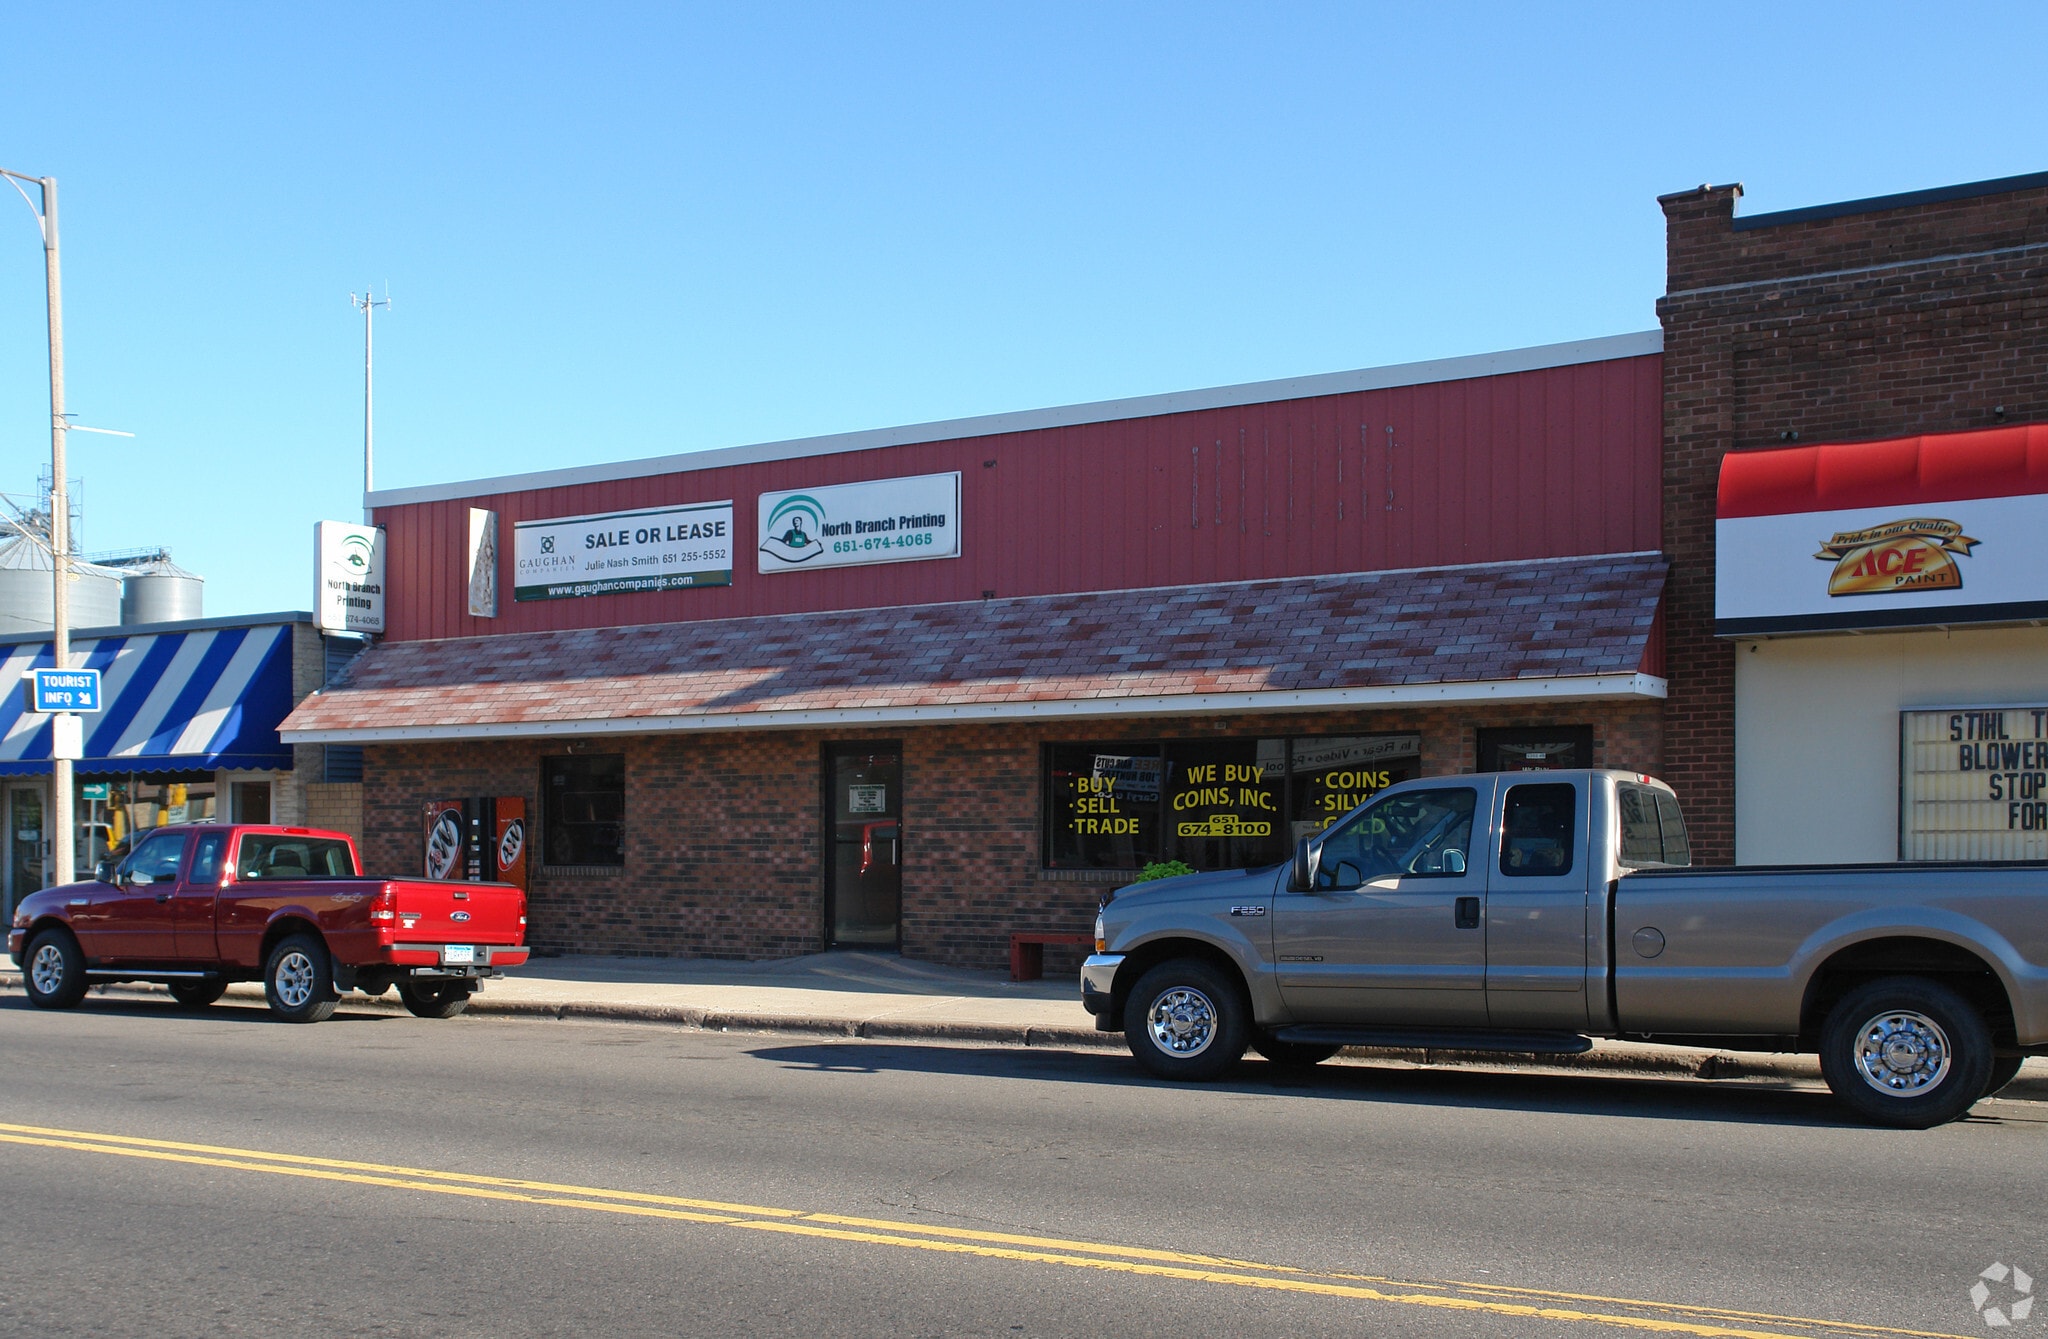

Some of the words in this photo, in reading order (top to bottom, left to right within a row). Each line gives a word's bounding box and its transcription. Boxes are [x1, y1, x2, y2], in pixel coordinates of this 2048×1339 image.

[585, 530, 629, 549] SALE
[635, 528, 661, 544] OR
[666, 521, 726, 541] LEASE
[822, 522, 852, 537] North
[855, 517, 895, 534] Branch
[899, 513, 945, 530] Printing
[1836, 533, 1867, 544] Pride
[1870, 529, 1881, 539] in
[1884, 524, 1907, 535] our
[1908, 520, 1954, 535] Quality
[833, 533, 932, 553] 651-674-4065
[519, 555, 575, 568] GAUGHAN
[585, 560, 605, 571] Julie
[607, 558, 629, 569] Nash
[632, 555, 658, 566] Smith
[662, 554, 677, 563] 651
[681, 549, 726, 562] 255-5552
[1851, 548, 1927, 577] ACE
[328, 579, 350, 591] North
[352, 581, 380, 594] Branch
[548, 576, 693, 596] www.gaughancompanies.com
[1895, 573, 1947, 585] PAINT
[337, 595, 371, 609] Printing
[42, 675, 92, 687] TOURIST
[45, 691, 72, 704] INFO
[1950, 712, 2009, 741] STIHL
[1960, 742, 2048, 771] BLOWER
[1077, 776, 1116, 793] BUY
[1187, 765, 1216, 784] WE
[1225, 765, 1264, 784] BUY
[1325, 771, 1390, 789] COINS
[1989, 772, 2046, 800] STOP
[1077, 797, 1120, 814] SELL
[1173, 787, 1235, 811] COINS,
[1239, 787, 1277, 812] INC.
[1075, 818, 1139, 834] TRADE
[1212, 816, 1236, 824] 651
[2009, 802, 2047, 830] FOR
[1180, 824, 1268, 835] 674-8100
[428, 815, 455, 880] A&W
[502, 821, 520, 865] A&W
